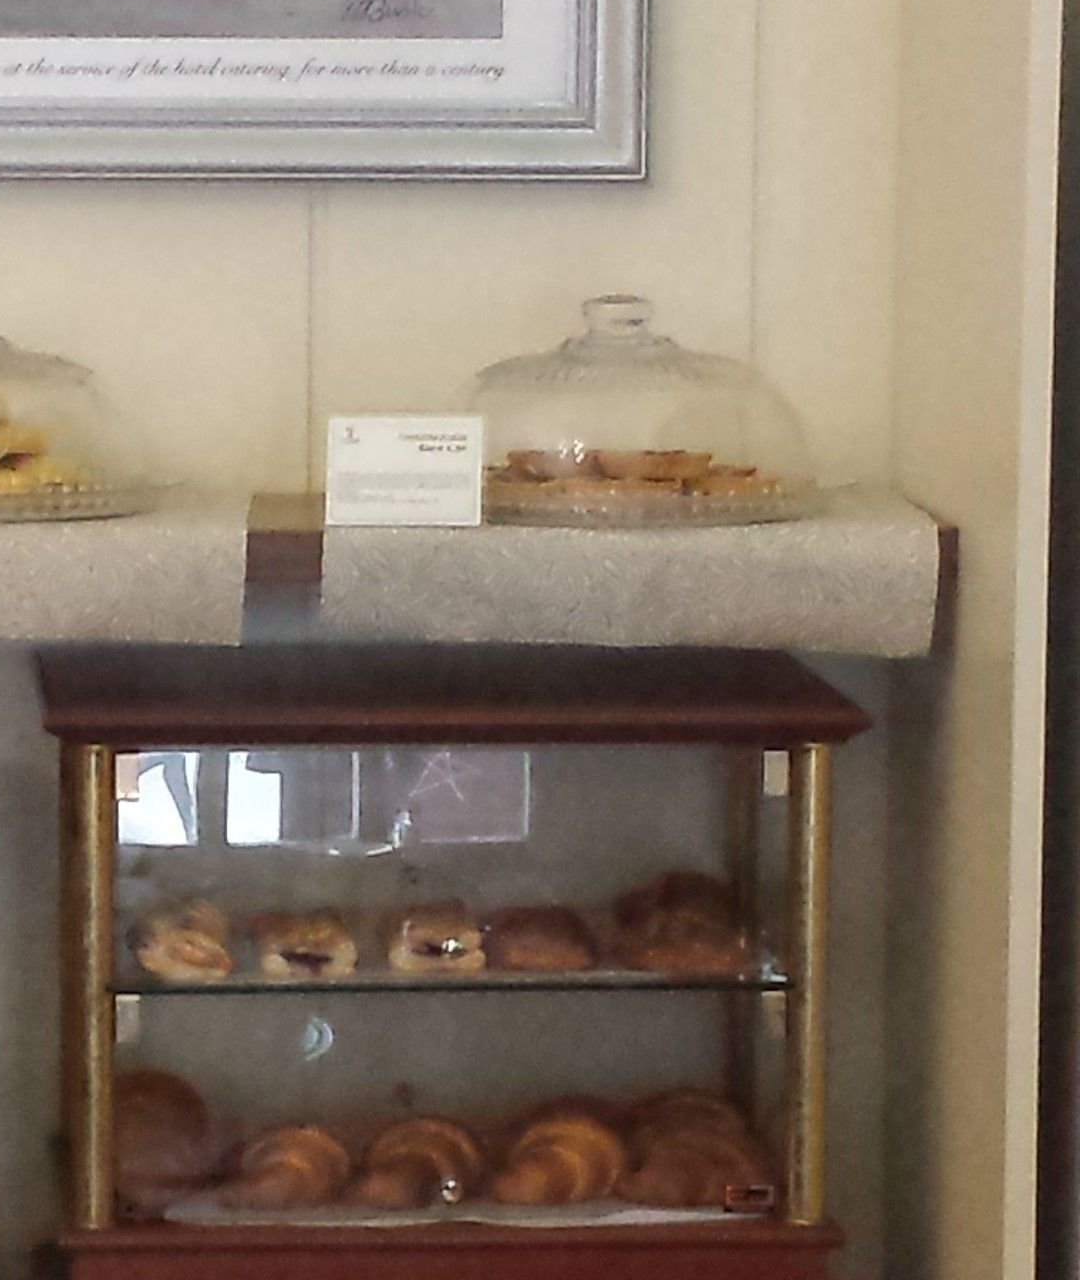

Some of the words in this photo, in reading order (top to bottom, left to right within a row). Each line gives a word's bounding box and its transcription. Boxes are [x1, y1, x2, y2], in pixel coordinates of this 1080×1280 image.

[2, 61, 23, 75] at
[26, 56, 55, 75] the
[120, 61, 140, 79] of
[146, 57, 168, 75] the
[174, 56, 221, 76] hotel
[295, 56, 326, 82] for
[331, 64, 373, 76] more
[381, 59, 419, 76] than
[424, 65, 436, 77] a
[441, 63, 505, 81] century
